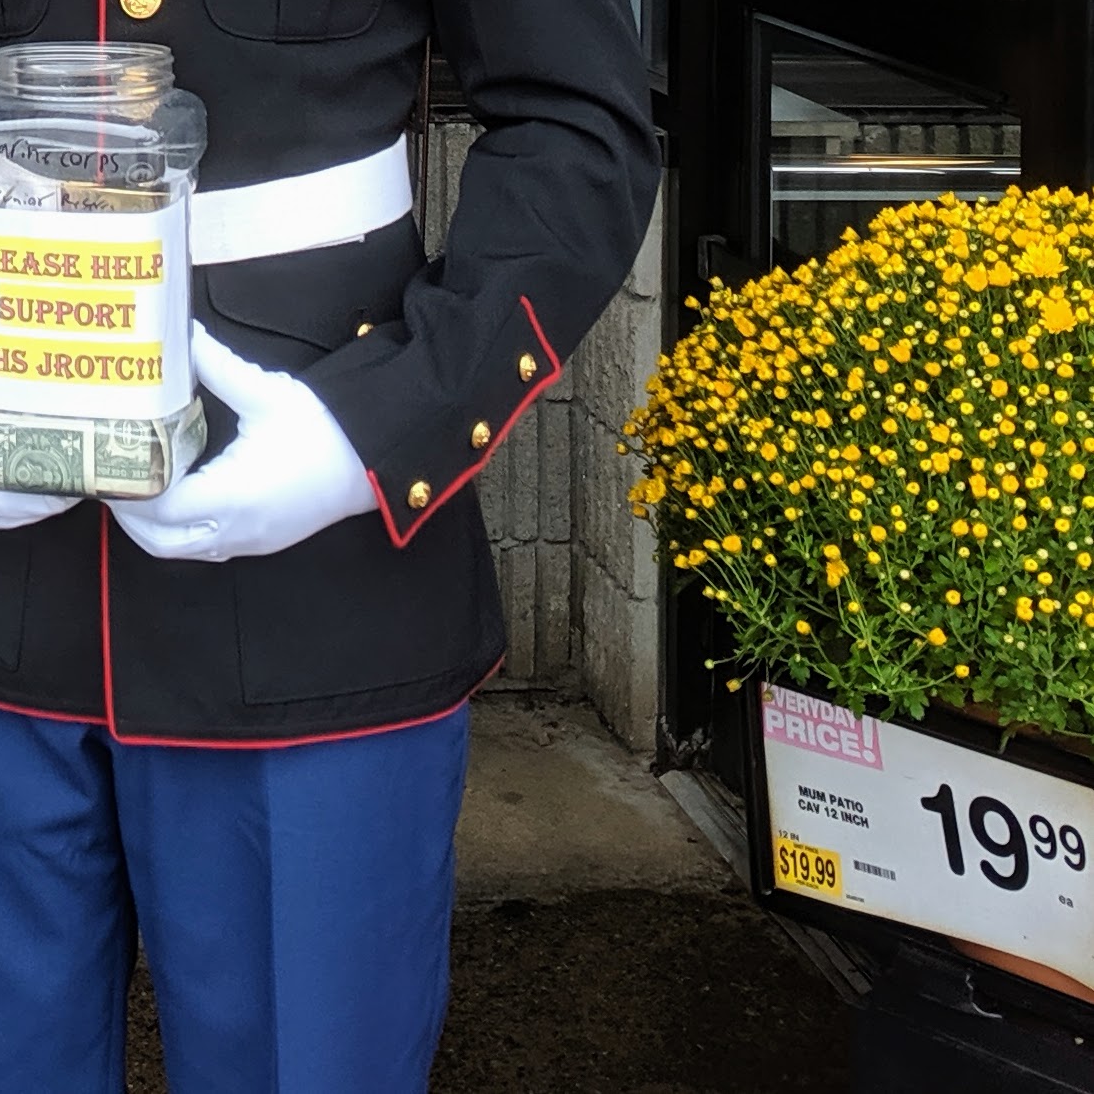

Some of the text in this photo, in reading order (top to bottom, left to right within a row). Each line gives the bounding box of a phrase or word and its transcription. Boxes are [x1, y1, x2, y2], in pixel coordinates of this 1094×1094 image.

[91, 253, 164, 280] HELP
[36, 352, 163, 382] JROTC!!!
[798, 785, 864, 814] MUM PATIO
[798, 798, 869, 829] CAV 12 INCH
[778, 829, 789, 839] 12
[779, 844, 836, 889] $19.99
[1058, 894, 1074, 908] ea
